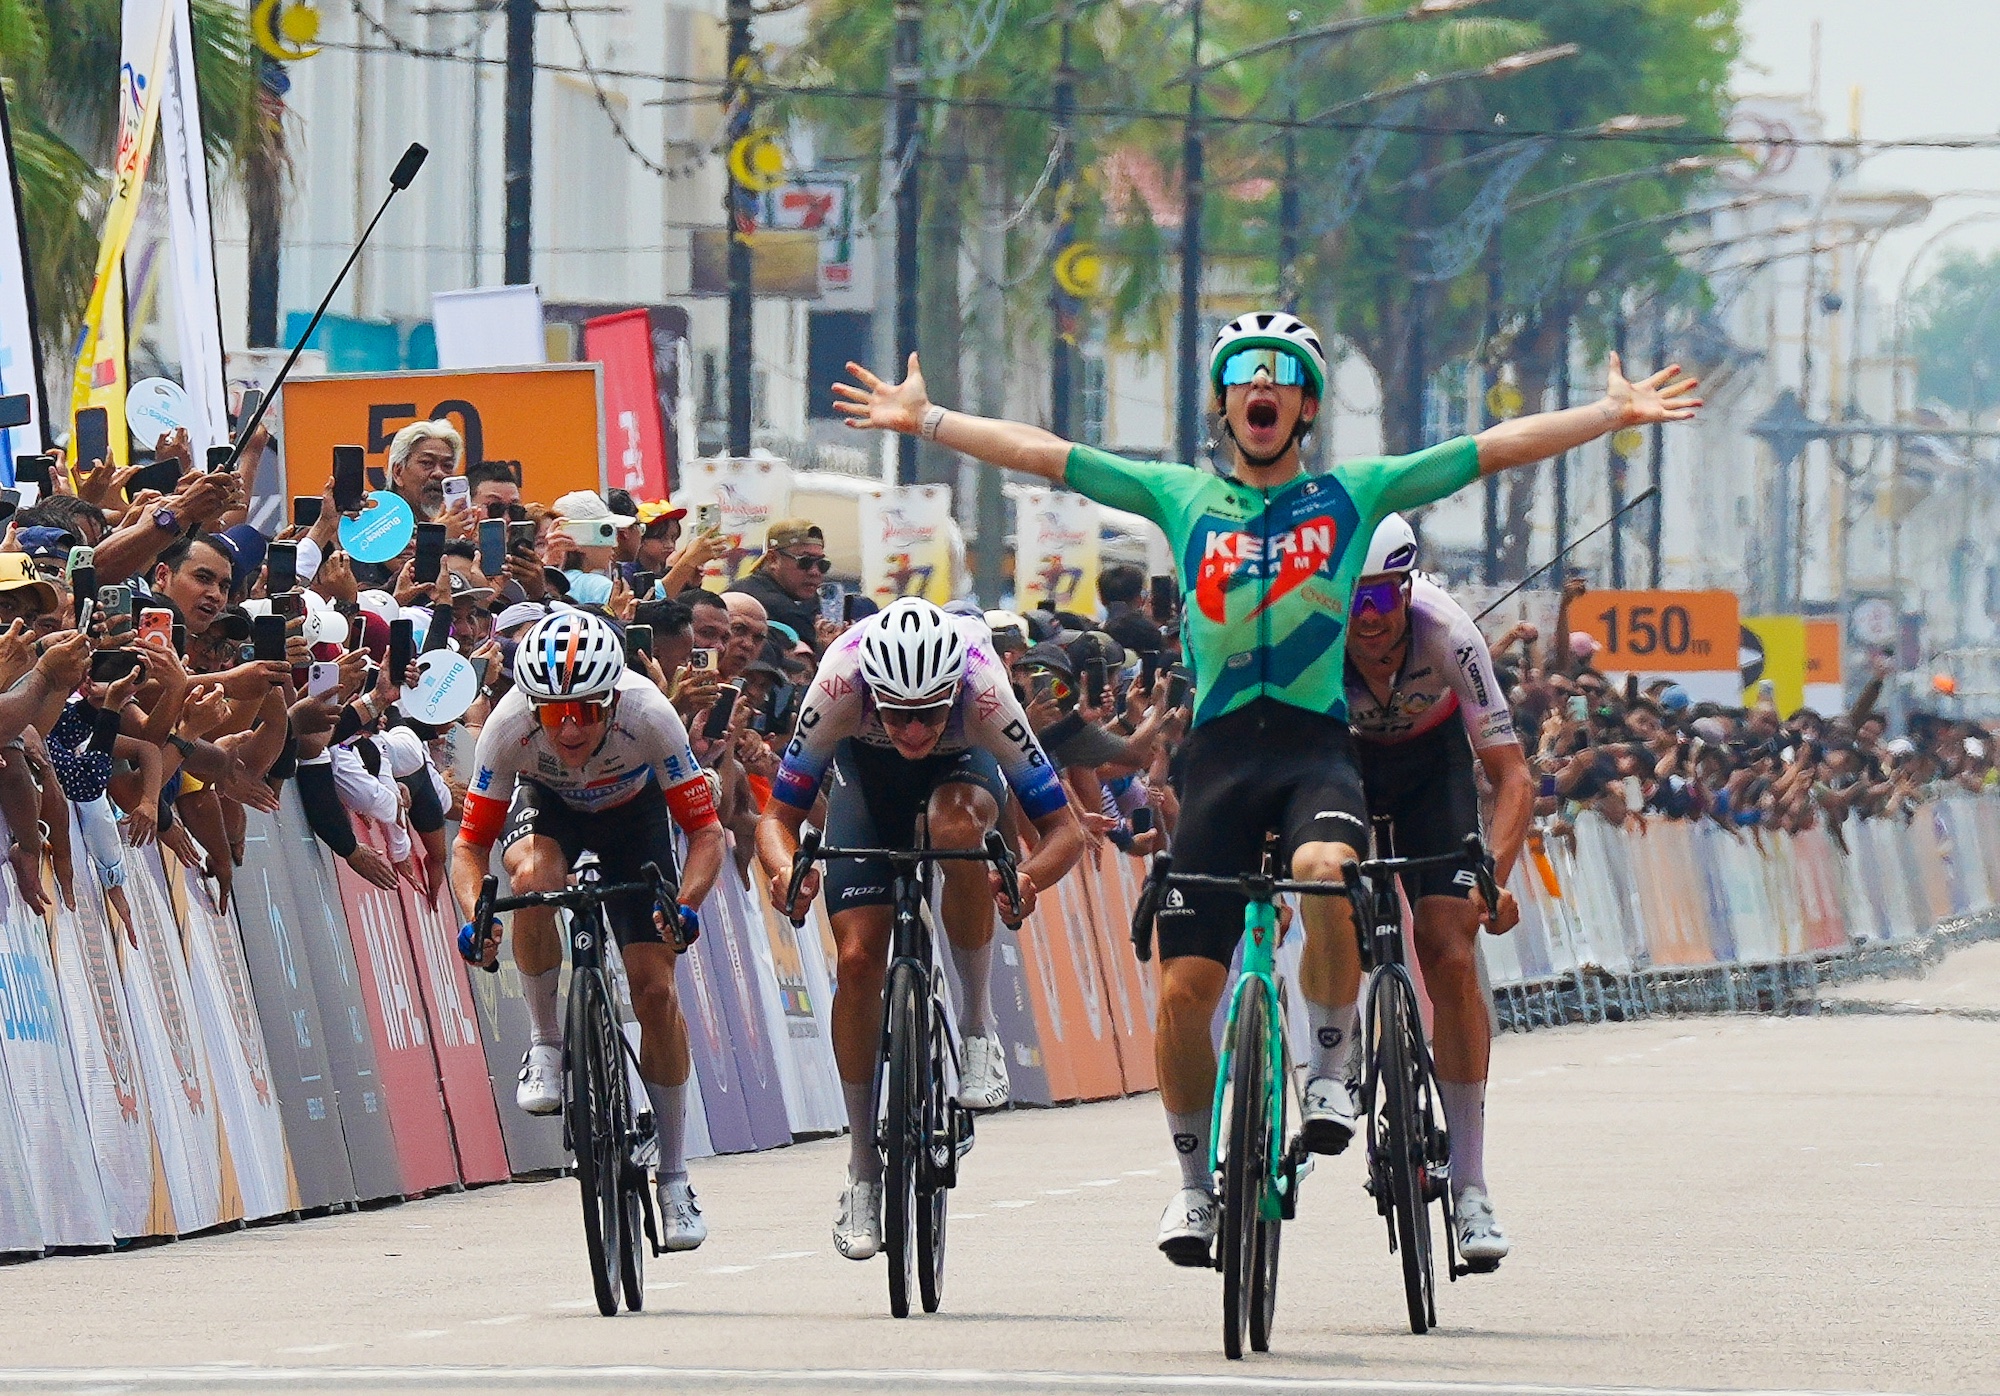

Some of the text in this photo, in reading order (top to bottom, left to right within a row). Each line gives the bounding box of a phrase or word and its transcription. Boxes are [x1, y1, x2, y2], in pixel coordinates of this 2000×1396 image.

[1204, 525, 1331, 561] KERN
[1204, 556, 1330, 579] PHARMA
[1598, 605, 1691, 656] 150
[421, 662, 464, 705] Bubbles
[1375, 924, 1398, 937] BH
